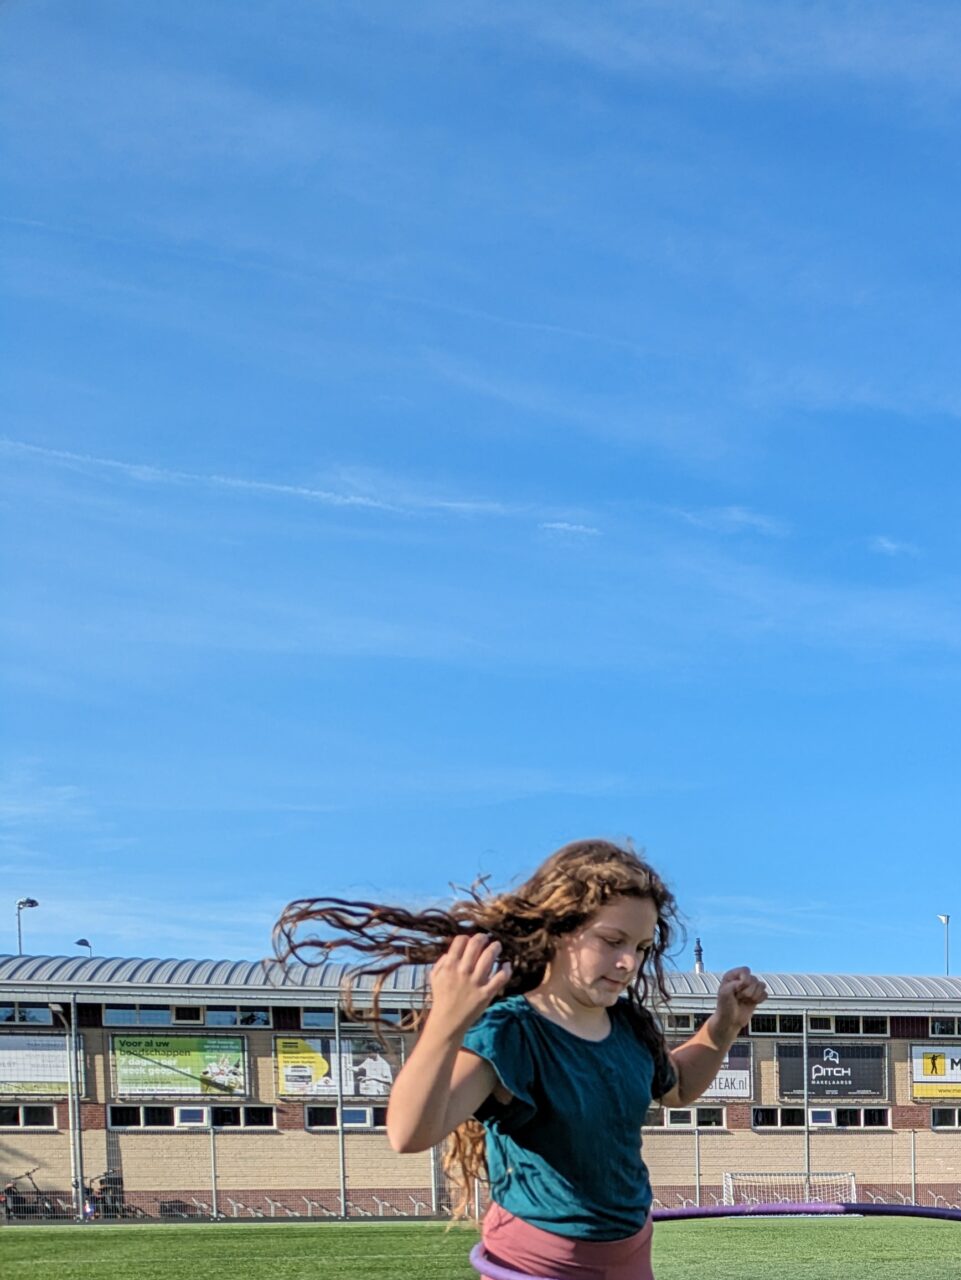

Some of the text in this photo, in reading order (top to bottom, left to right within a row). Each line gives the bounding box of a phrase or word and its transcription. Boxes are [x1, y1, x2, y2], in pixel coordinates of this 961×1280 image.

[144, 1039, 153, 1047] al
[119, 1049, 191, 1057] boodschappen
[811, 1064, 851, 1079] PITCH
